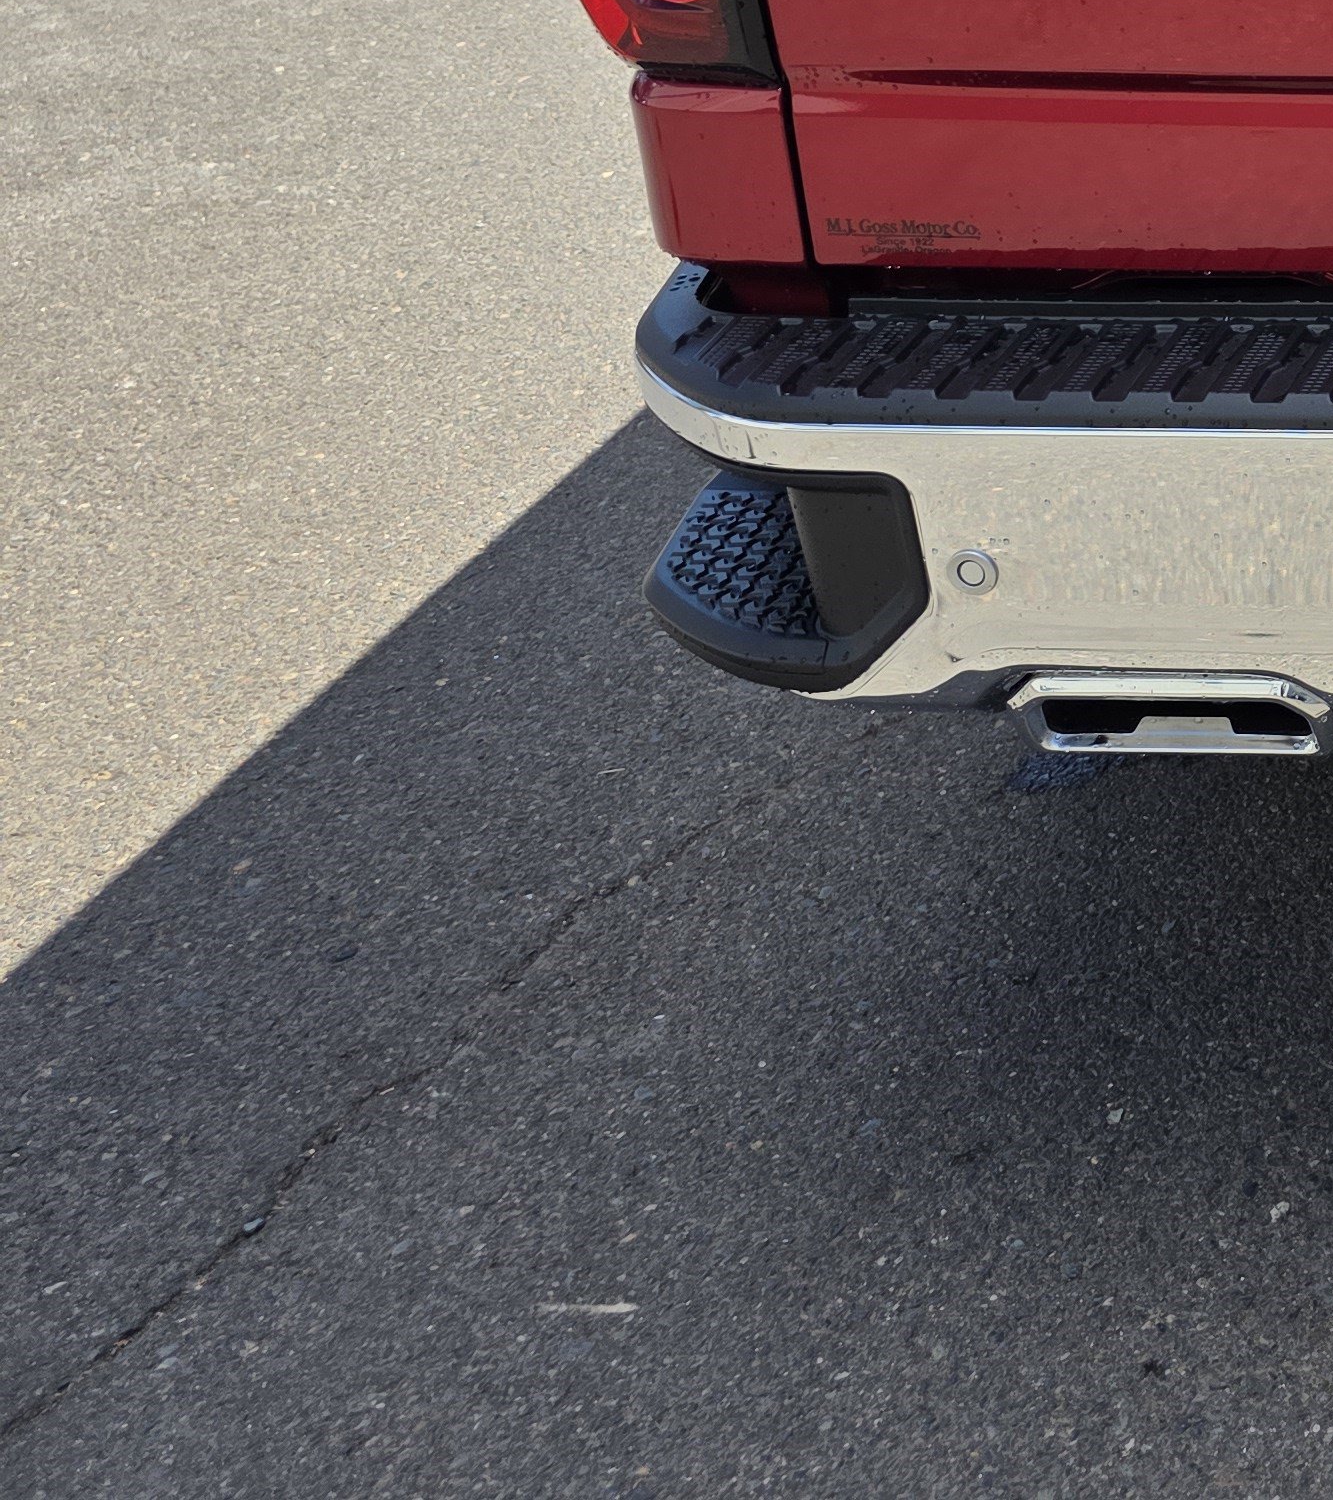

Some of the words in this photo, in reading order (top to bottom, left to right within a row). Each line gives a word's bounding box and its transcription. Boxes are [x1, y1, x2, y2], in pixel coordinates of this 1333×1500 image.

[858, 218, 898, 234] Goss
[901, 219, 951, 236] Motor
[953, 220, 982, 236] Co.
